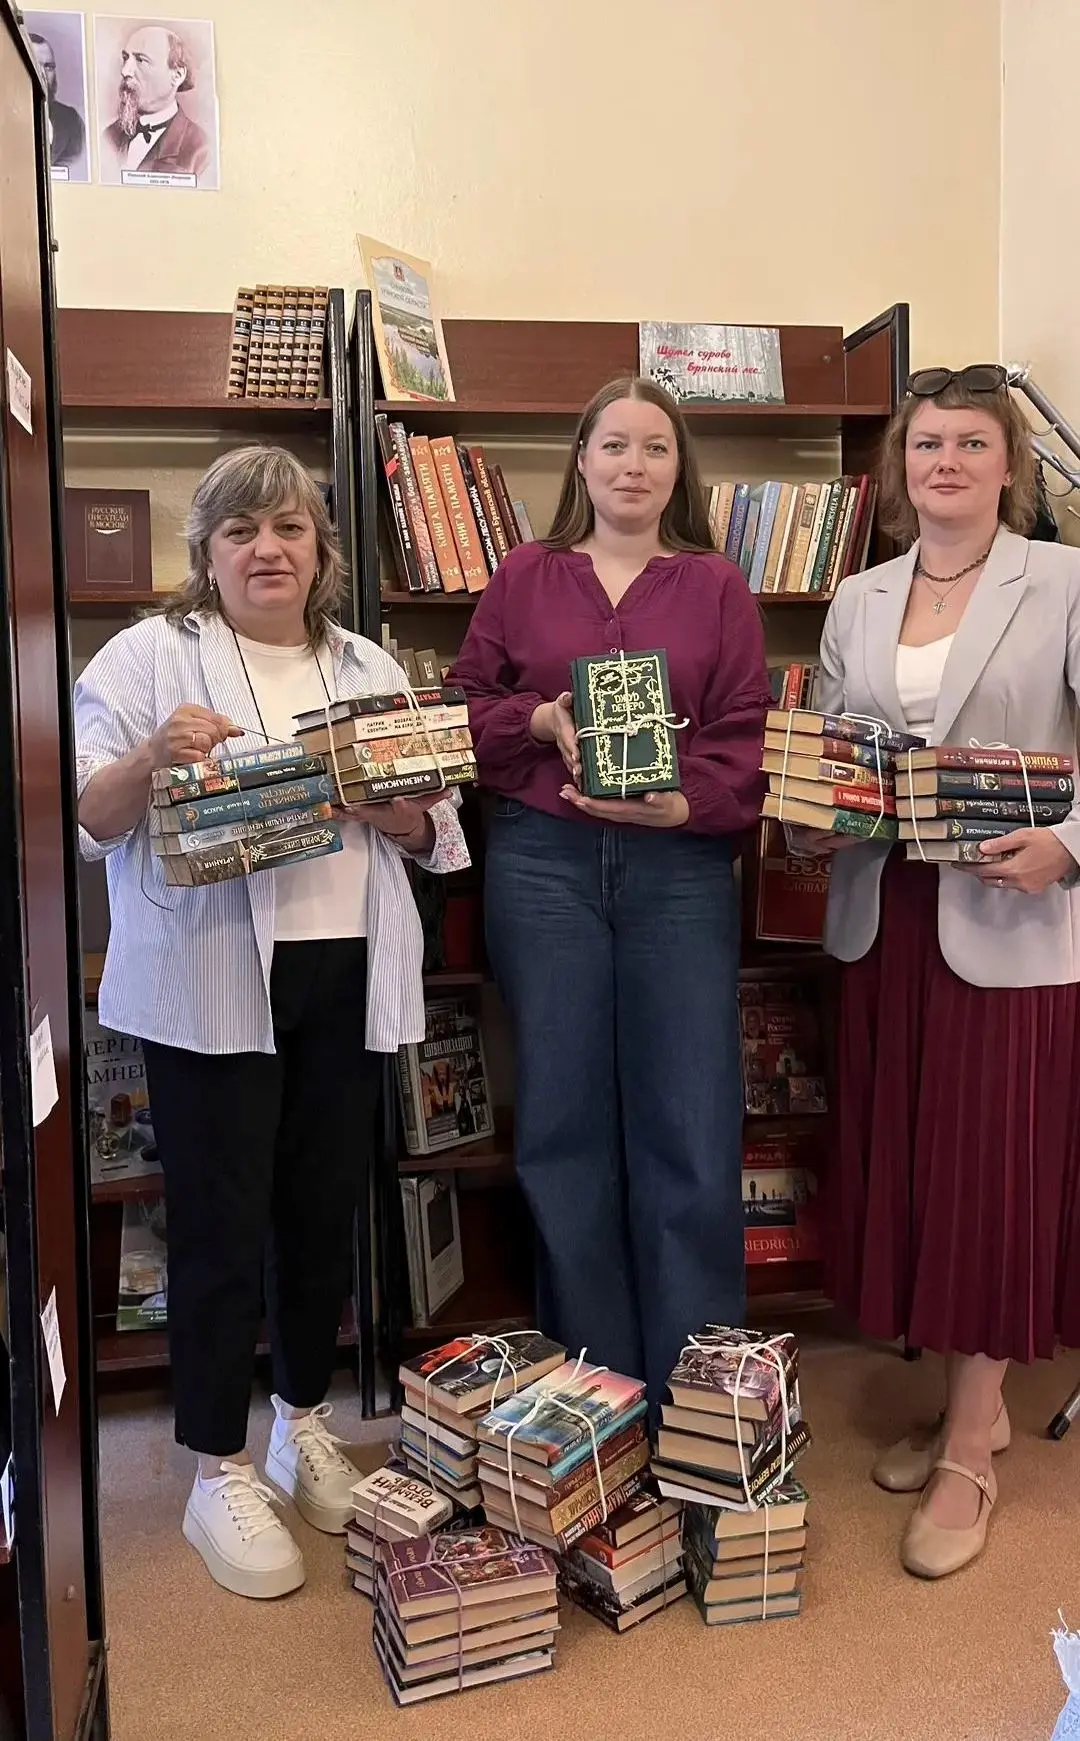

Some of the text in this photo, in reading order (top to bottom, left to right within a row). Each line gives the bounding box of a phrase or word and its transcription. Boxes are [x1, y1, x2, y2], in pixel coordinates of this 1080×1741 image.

[656, 345, 731, 362] Шумел сурово
[687, 362, 738, 375] Брянский
[417, 462, 438, 510] ПАМЯТИ
[476, 457, 489, 487] области
[441, 463, 470, 548] КНИГА ПАМЯТИ
[469, 485, 484, 517] ТИШИНА
[484, 489, 500, 526] Брянской
[825, 496, 839, 529] БЕЖИЦА
[431, 512, 448, 548] КНИГА
[465, 551, 472, 560] 2
[1020, 755, 1059, 766] БУШКО
[371, 774, 431, 793] Ф.НЕЗНАНСКИЙ
[300, 834, 320, 847] ЮРИЙ
[203, 855, 234, 868] АРТАНИЯ
[744, 1238, 800, 1253] RIEDRICH
[372, 1476, 434, 1509] ВЕДЬМИН
[581, 1487, 627, 1532] МАРАННА
